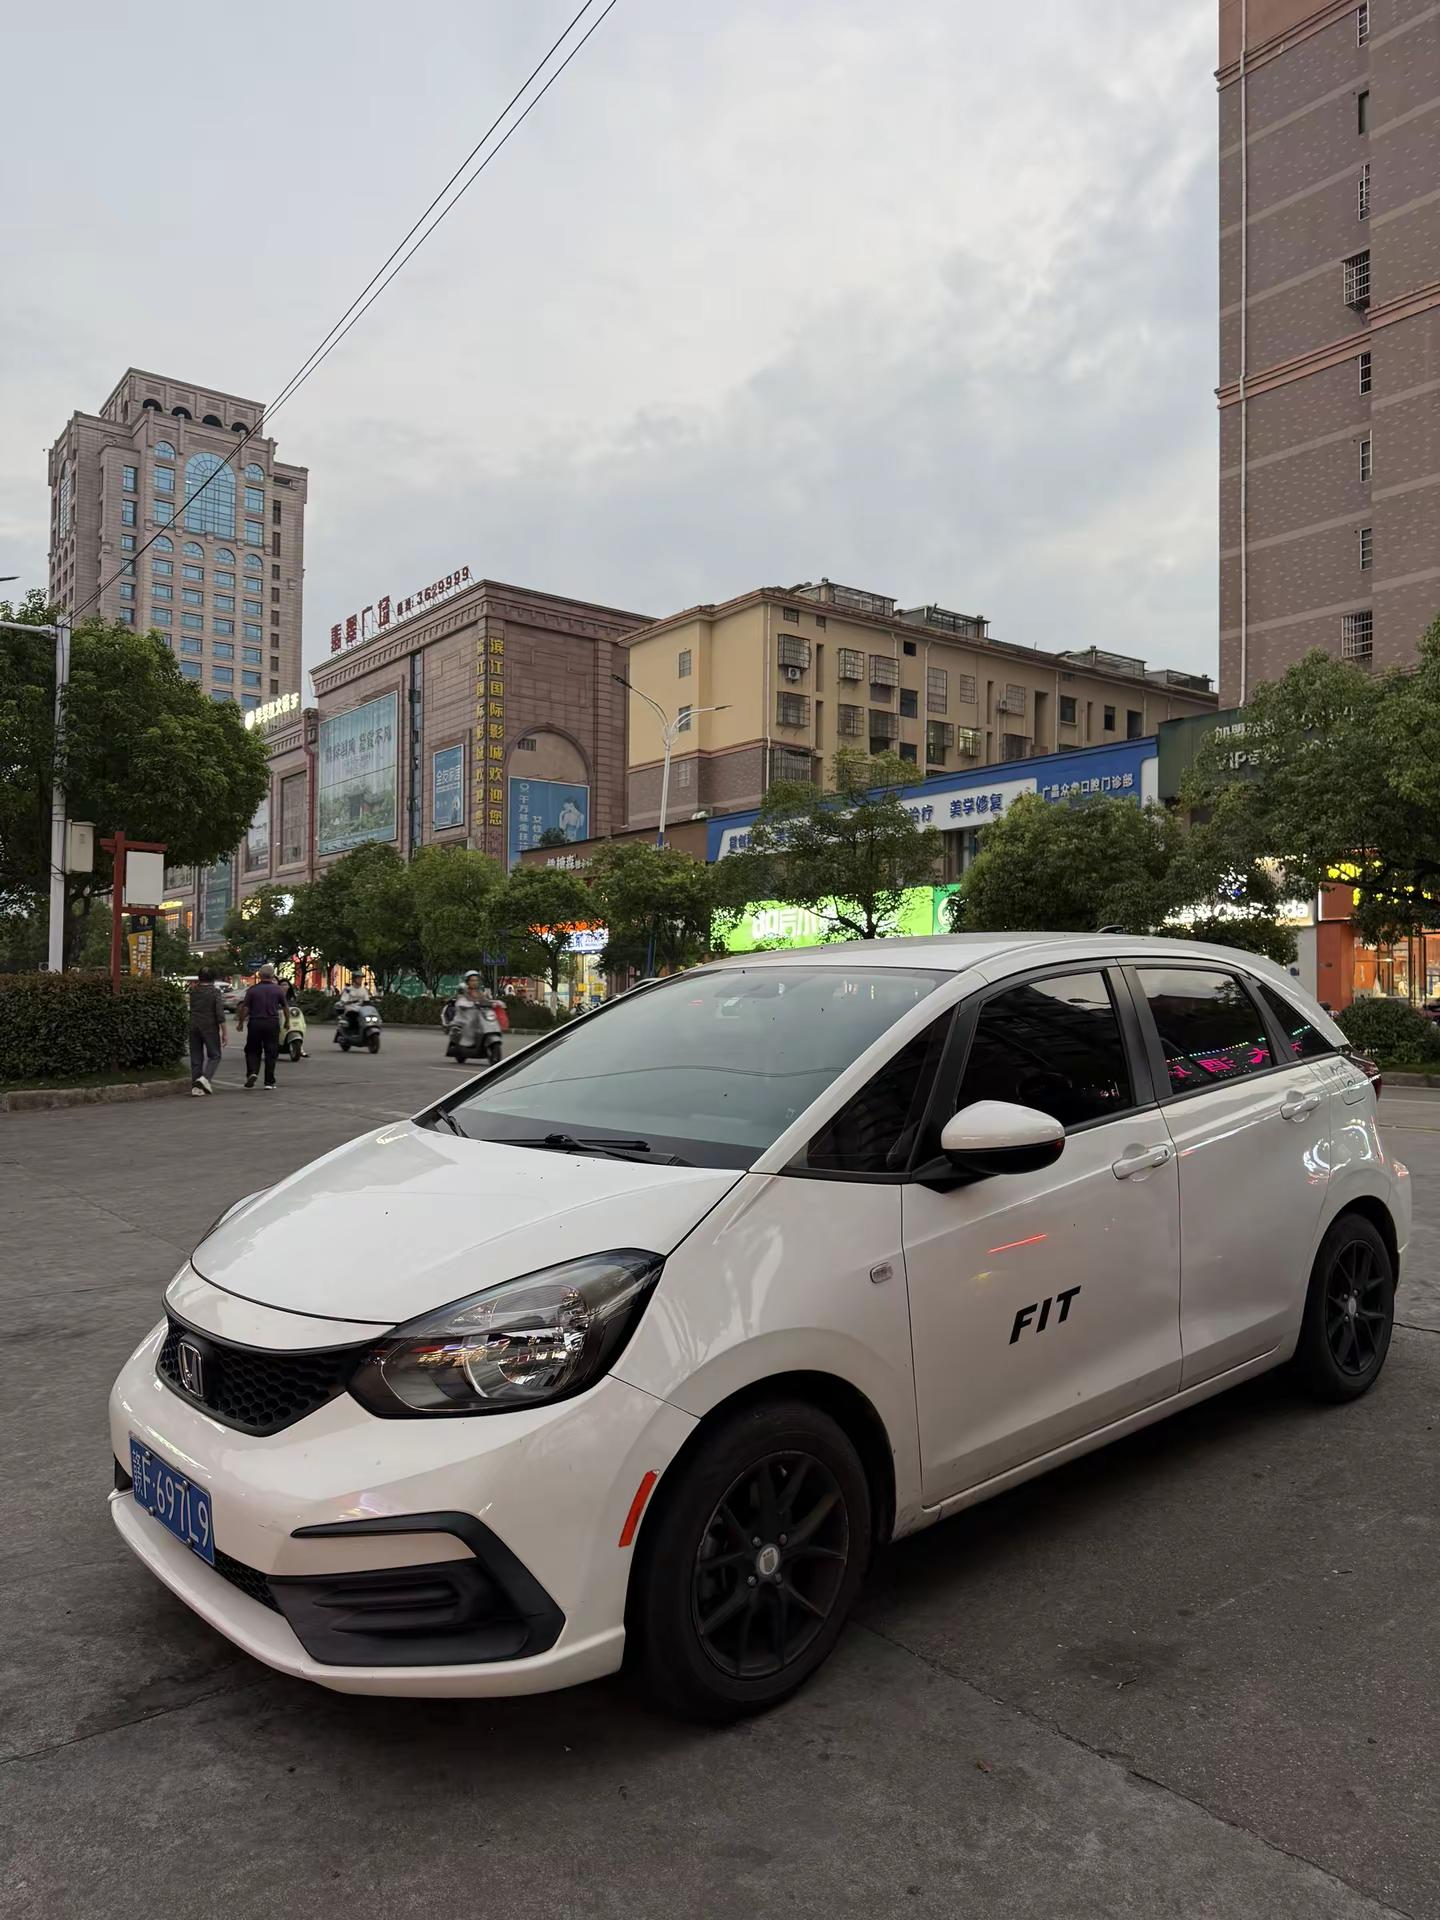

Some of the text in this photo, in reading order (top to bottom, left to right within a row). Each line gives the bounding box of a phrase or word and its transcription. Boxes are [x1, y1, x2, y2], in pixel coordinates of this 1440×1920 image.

[489, 637, 504, 826] 滨江国际影城欢迎您
[950, 793, 1002, 818] 美学修复
[1009, 1285, 1081, 1345] FIT
